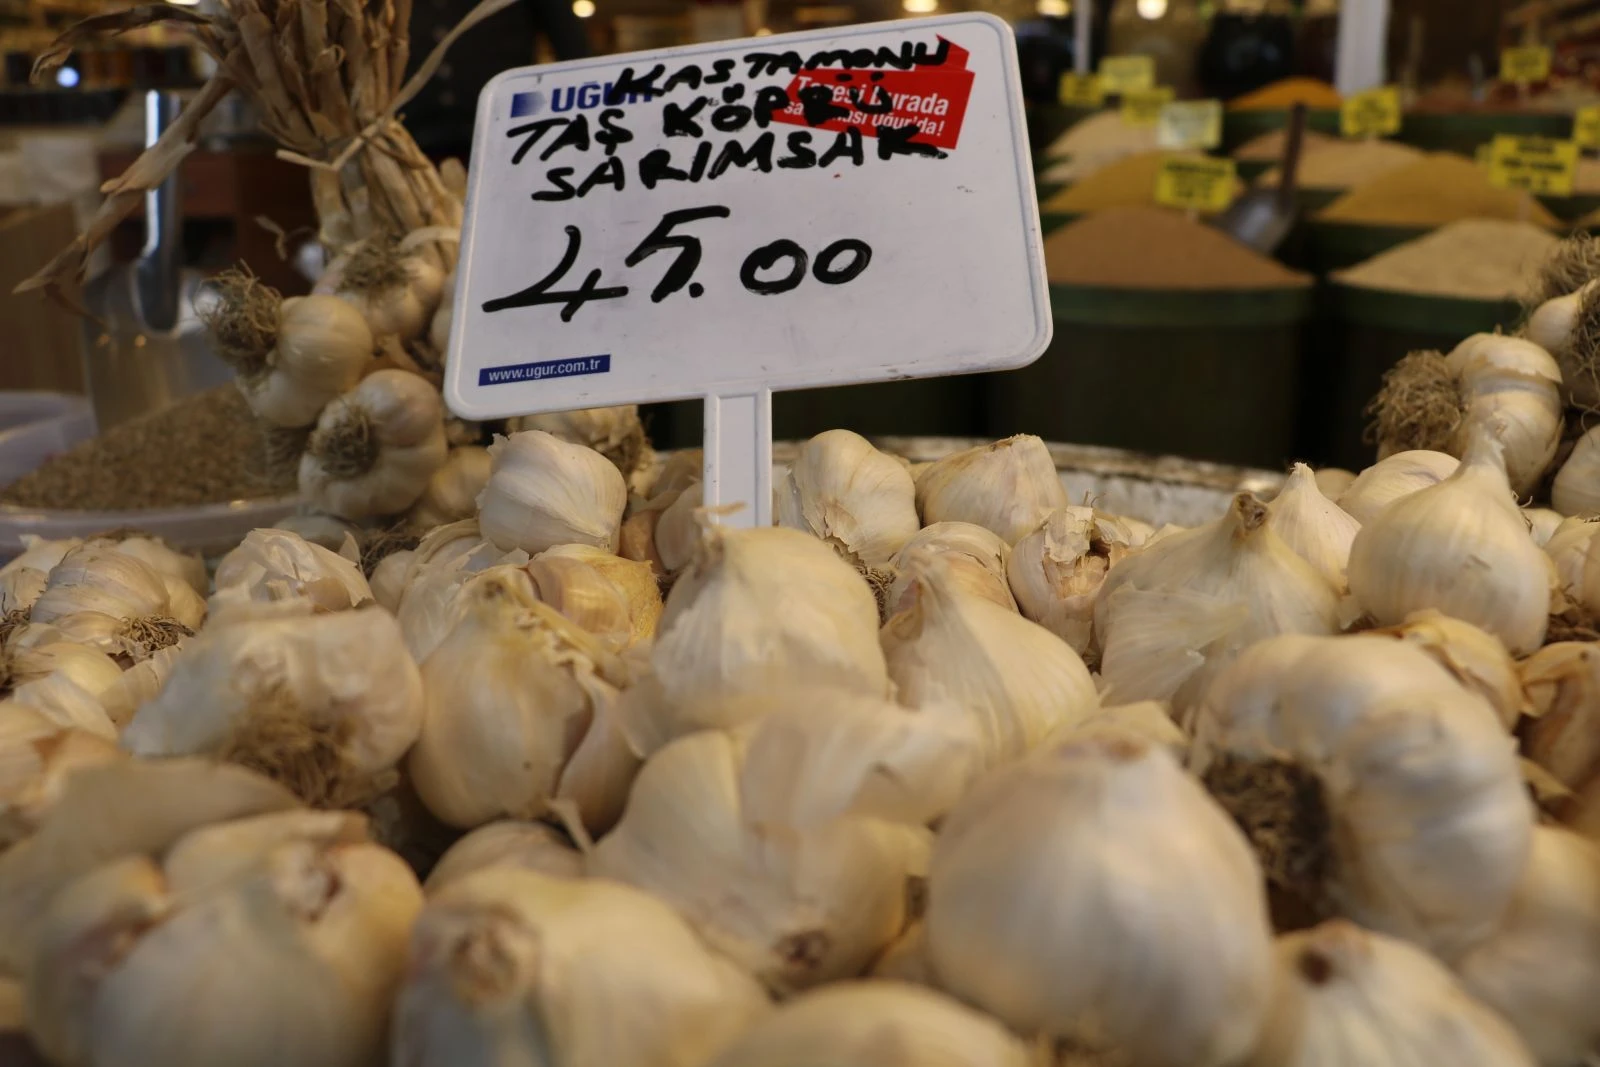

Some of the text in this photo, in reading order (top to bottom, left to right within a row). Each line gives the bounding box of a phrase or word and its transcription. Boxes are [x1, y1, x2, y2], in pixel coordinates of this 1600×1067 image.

[607, 41, 951, 106] KASTAMONU
[506, 108, 634, 166] TAŞ
[531, 124, 949, 202] SARIMSAK
[488, 359, 601, 382] www.ugur.com.tr
